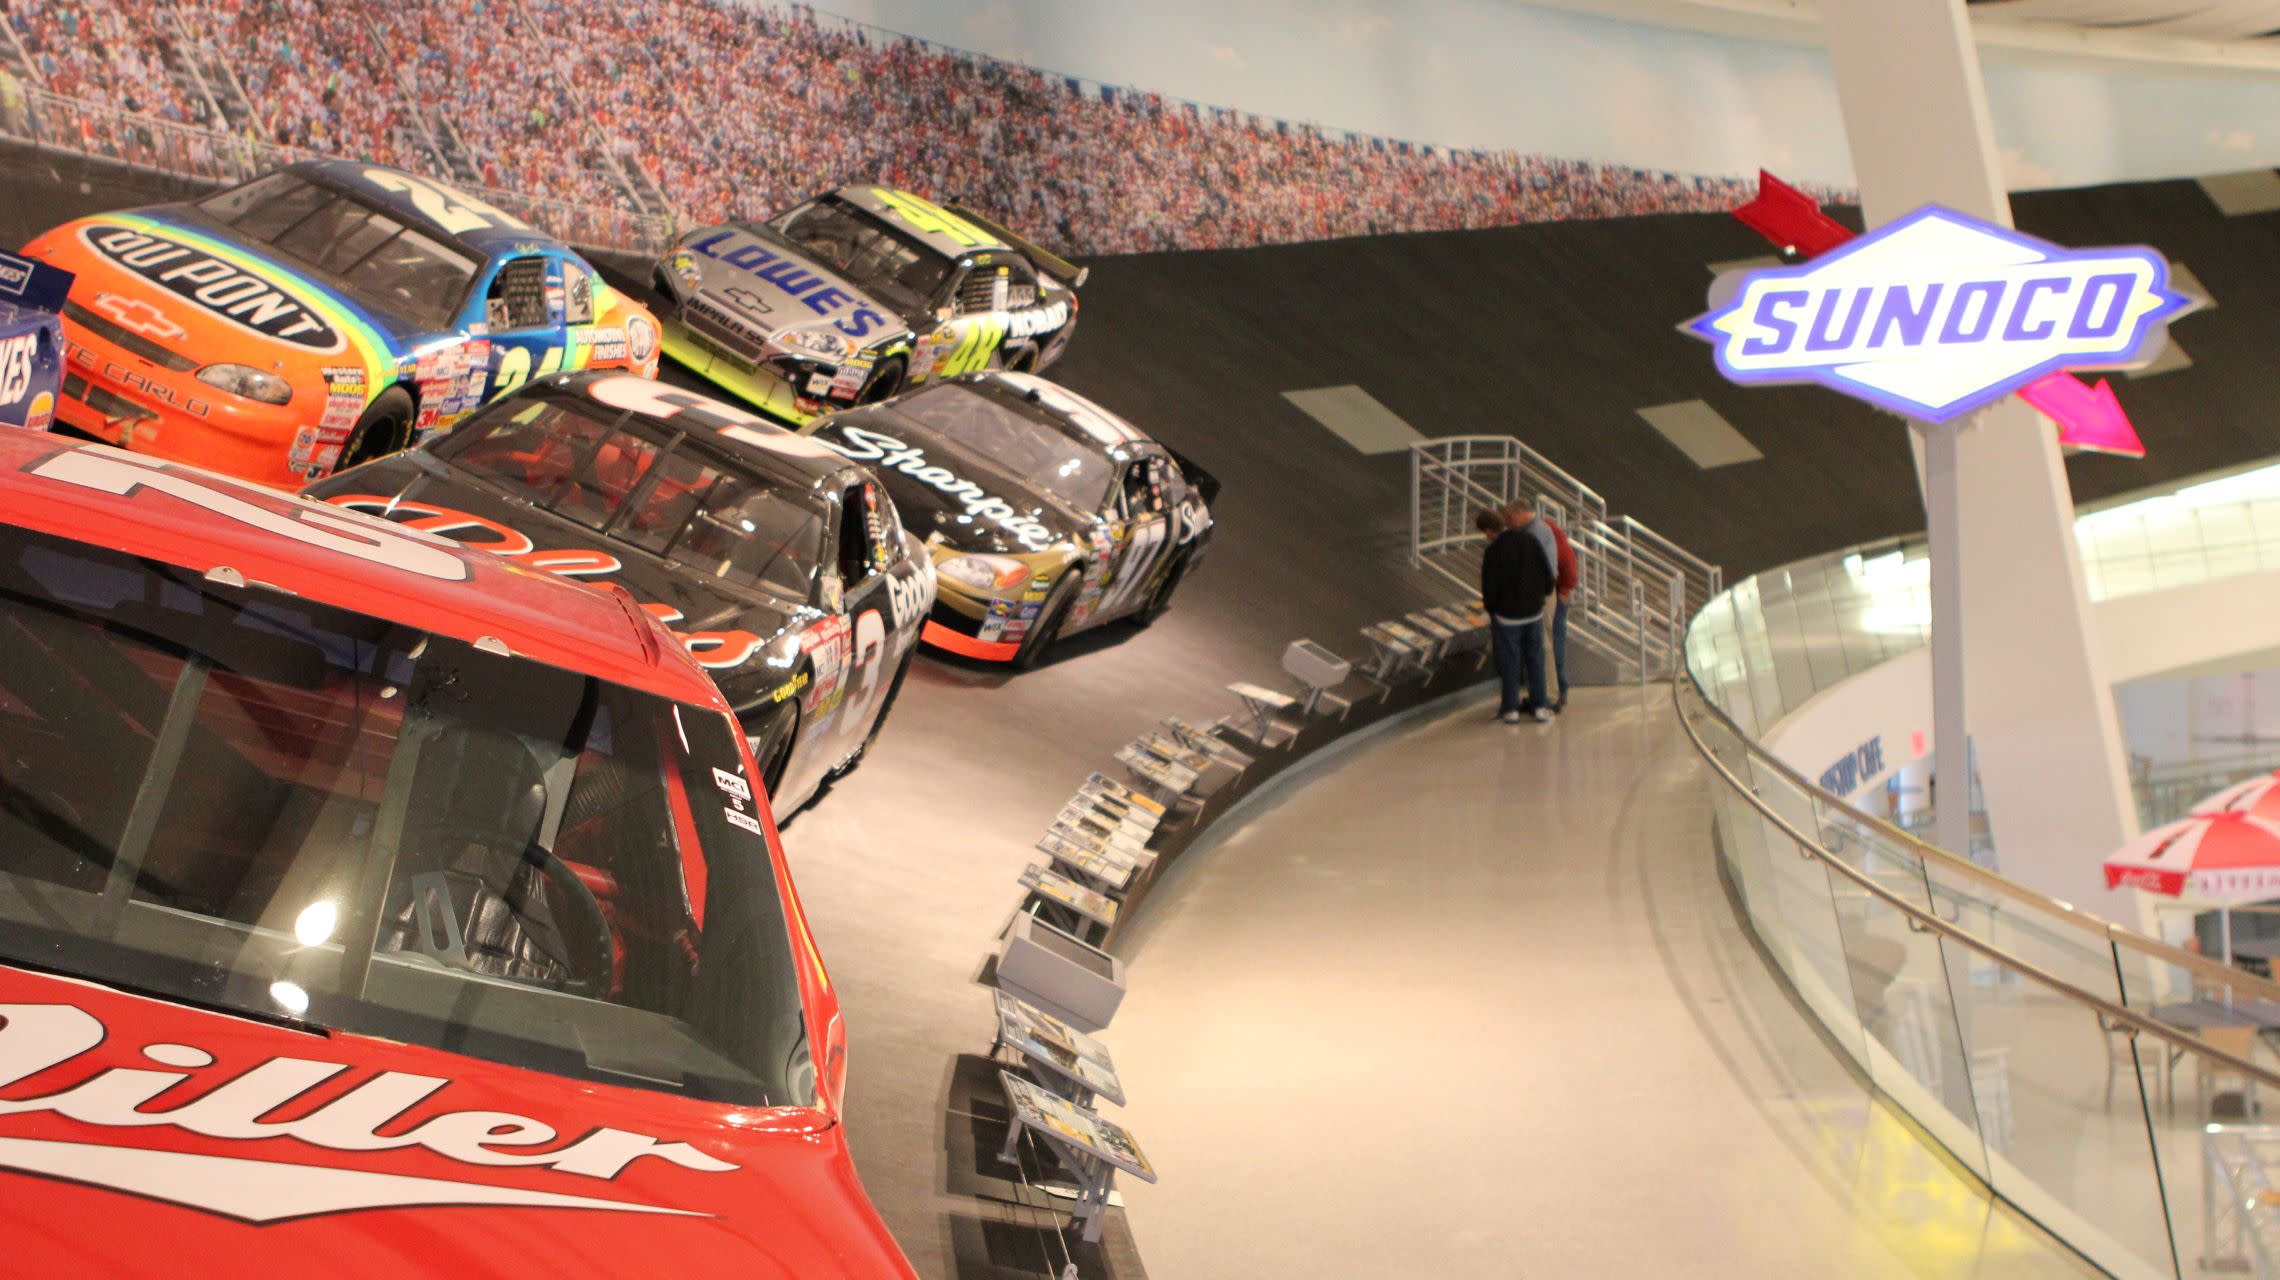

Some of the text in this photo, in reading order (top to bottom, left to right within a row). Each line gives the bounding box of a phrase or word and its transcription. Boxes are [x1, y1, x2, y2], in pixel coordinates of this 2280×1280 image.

[99, 231, 324, 337] DU PONT
[691, 231, 886, 337] LOWE'S
[1741, 272, 2138, 356] SUNOCO
[66, 341, 209, 417] TE CARLO
[330, 383, 366, 395] MOOG
[416, 409, 440, 429] 3M
[810, 426, 1050, 551] Sharpie
[840, 608, 885, 736] 3
[717, 775, 745, 793] MCI
